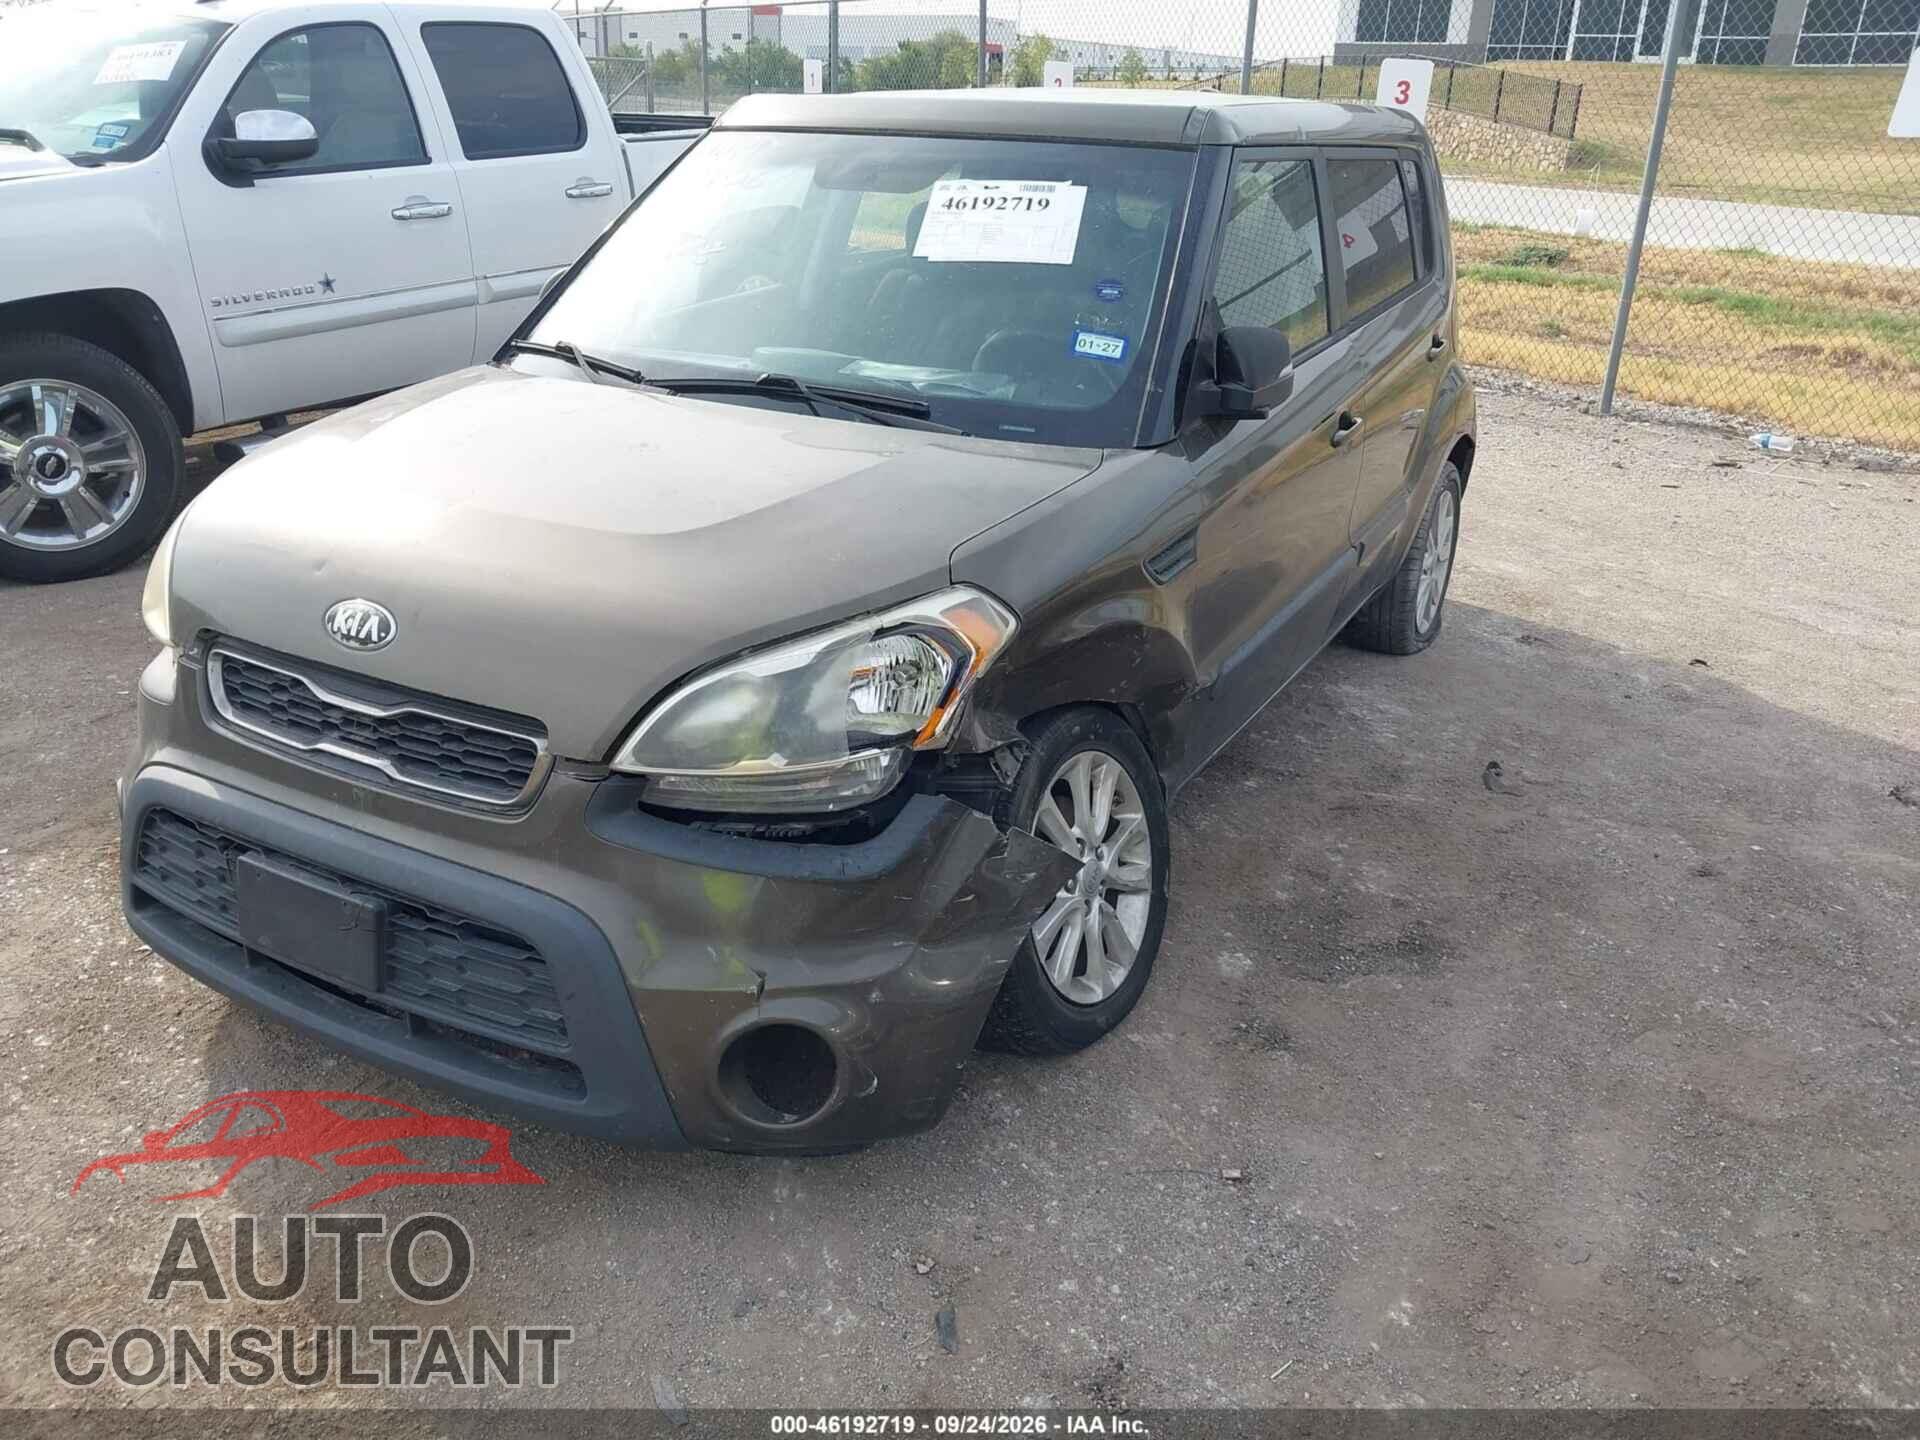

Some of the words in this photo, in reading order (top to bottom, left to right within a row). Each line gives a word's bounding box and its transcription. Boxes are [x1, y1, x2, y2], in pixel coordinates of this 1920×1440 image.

[1394, 80, 1411, 105] 3
[941, 195, 1051, 212] 46192719
[210, 283, 316, 307] SILVERADO
[1078, 338, 1121, 354] 01-27
[331, 606, 381, 643] KIA
